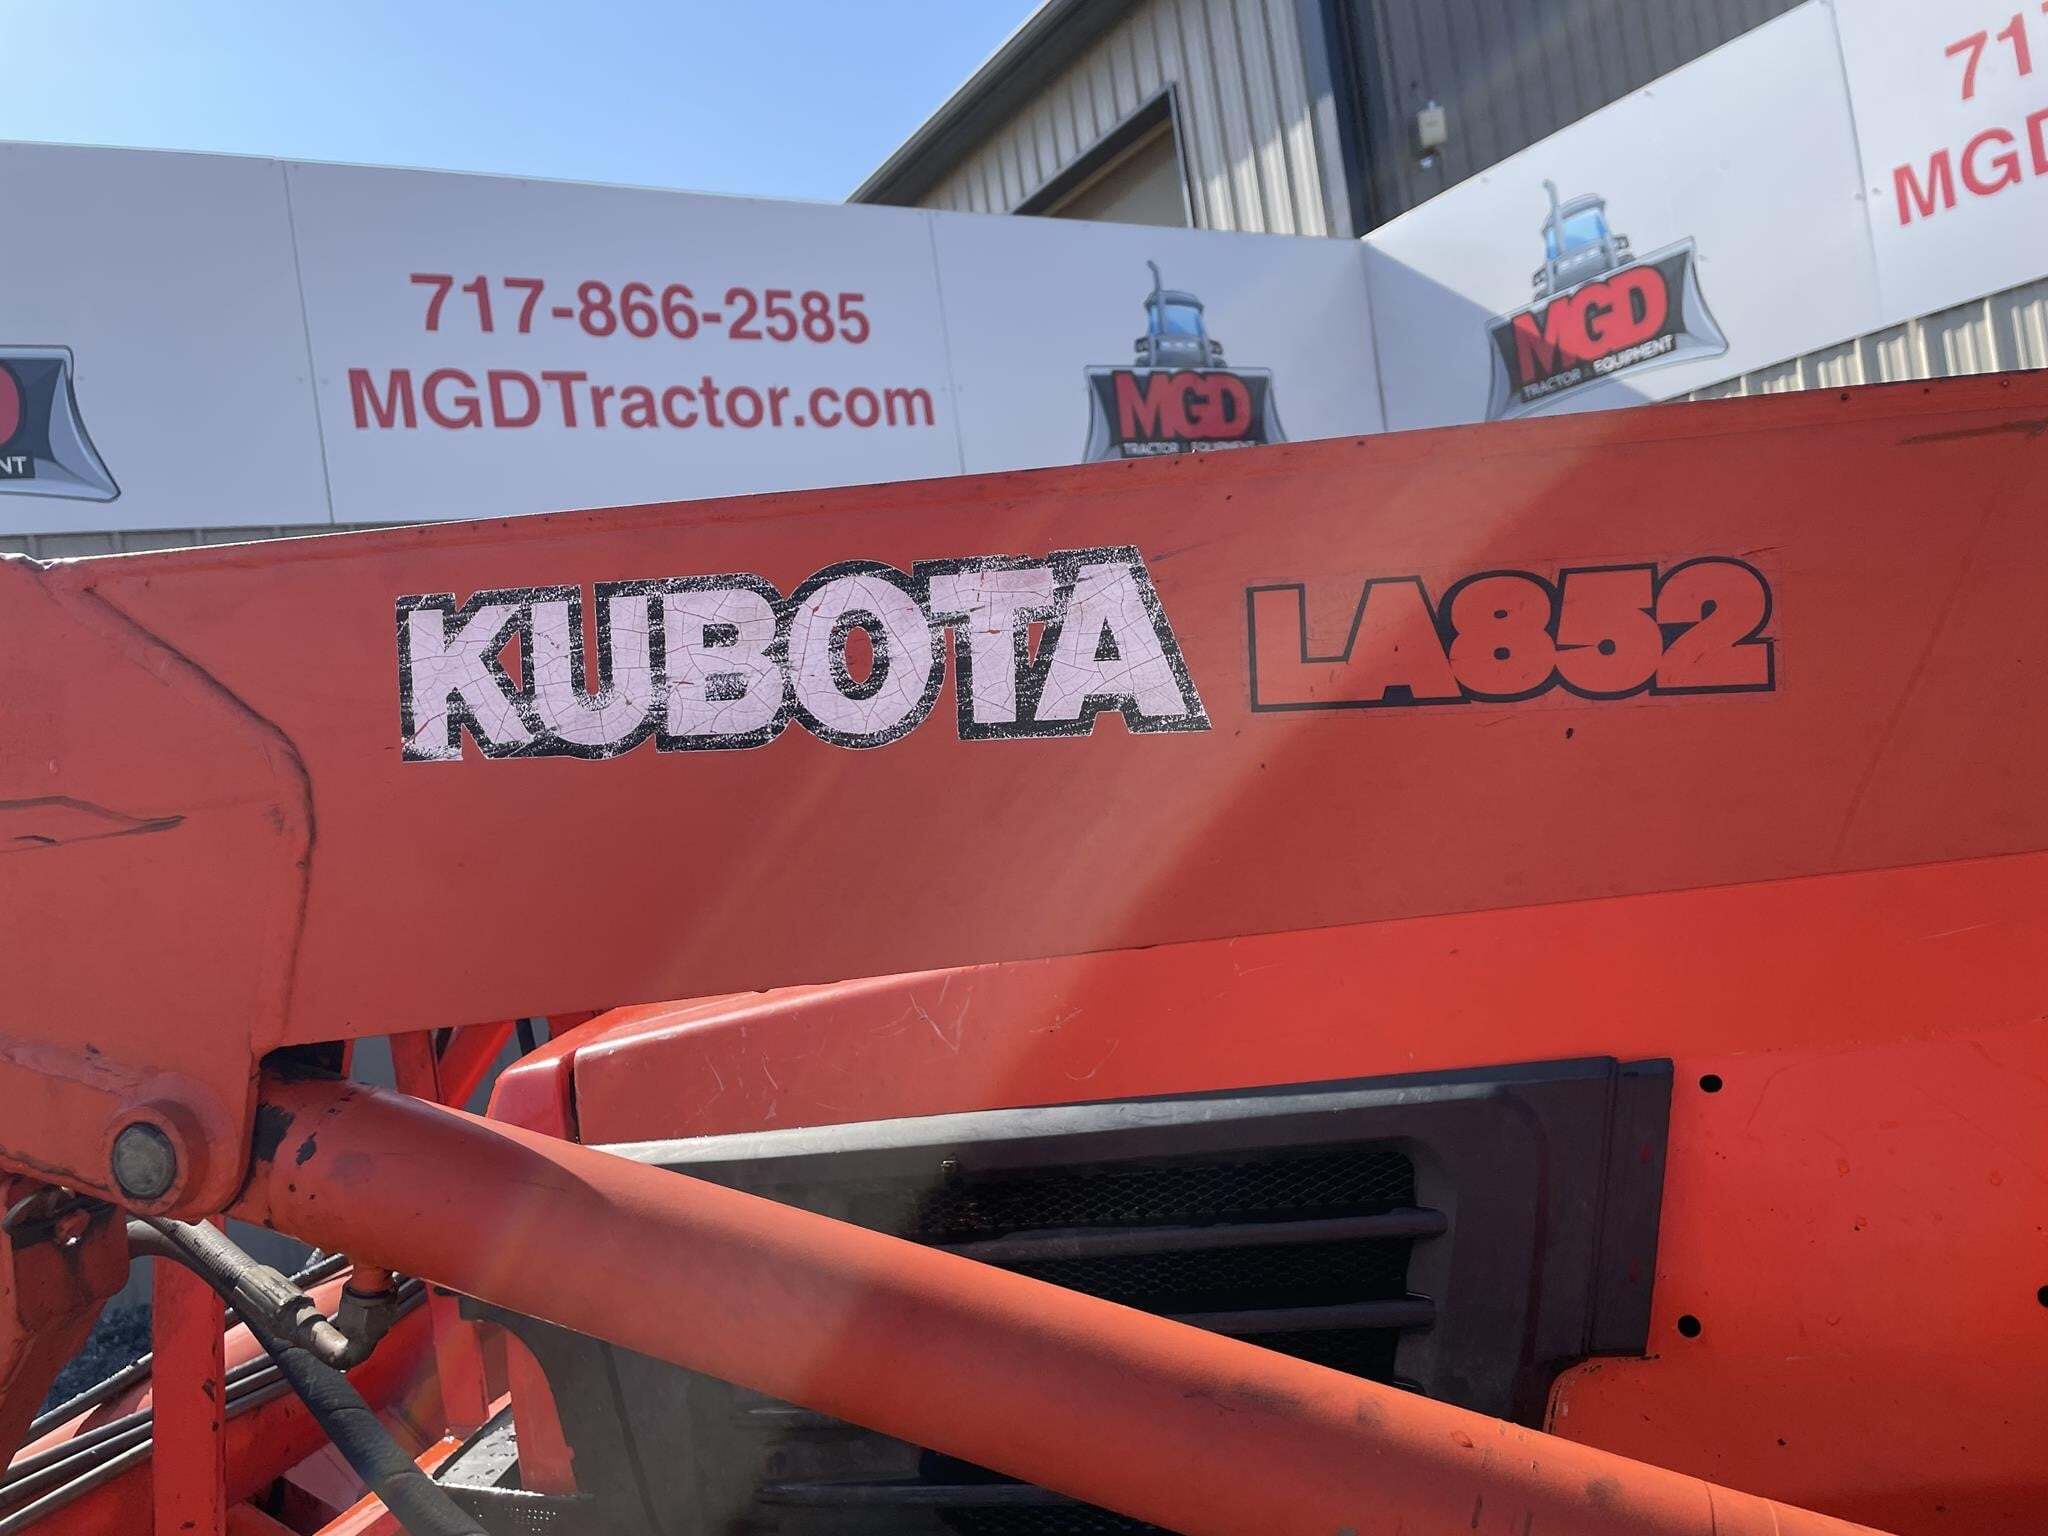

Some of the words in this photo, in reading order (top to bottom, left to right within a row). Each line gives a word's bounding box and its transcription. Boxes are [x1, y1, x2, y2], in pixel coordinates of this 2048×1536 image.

[1944, 0, 2048, 100] 71
[410, 272, 870, 344] 717-866-2585
[1511, 264, 1668, 382] MGD
[348, 367, 935, 430] MGDTractor.com
[1523, 367, 1582, 400] TRACTOR
[1593, 334, 1674, 374] EQUIPMENT
[1112, 371, 1252, 440] MGD
[396, 545, 1212, 762] KUBOTA
[1246, 555, 1776, 712] LA852
